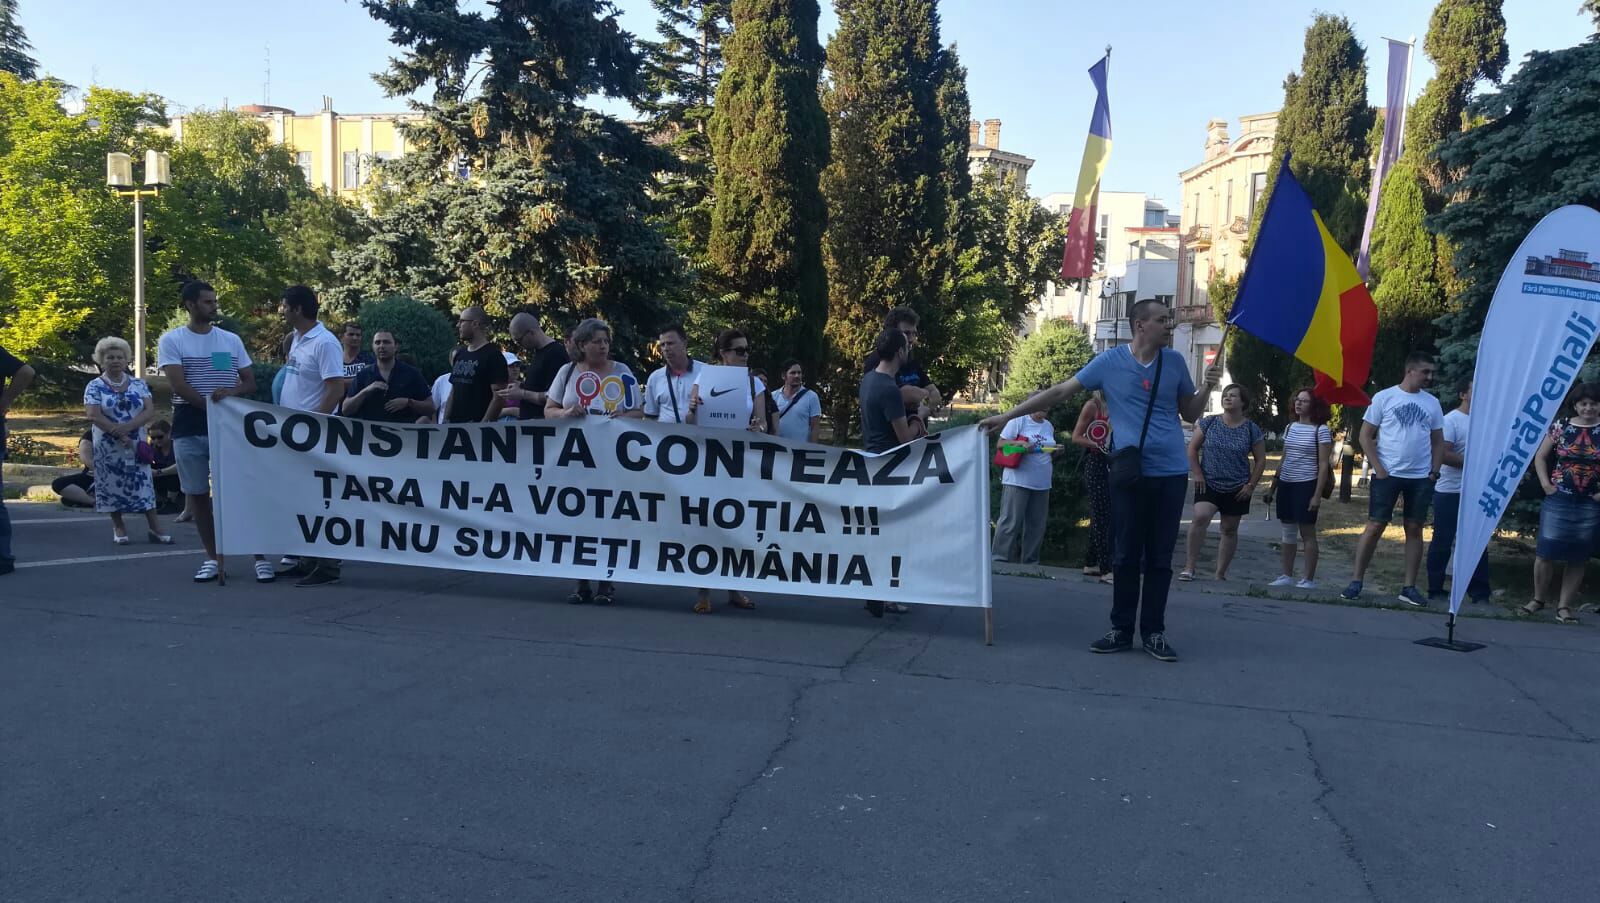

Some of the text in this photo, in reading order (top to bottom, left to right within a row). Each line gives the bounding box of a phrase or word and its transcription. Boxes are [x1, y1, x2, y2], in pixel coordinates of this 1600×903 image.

[243, 410, 956, 486] CONSTANȚA CONTEAZĂ
[1478, 311, 1597, 518] #FărăPenali
[314, 470, 880, 543] ȚARA N-A VOTAT HOȚIA !!!
[297, 514, 902, 588] VOI NU SUNTEȚI ROMÂNIA !
